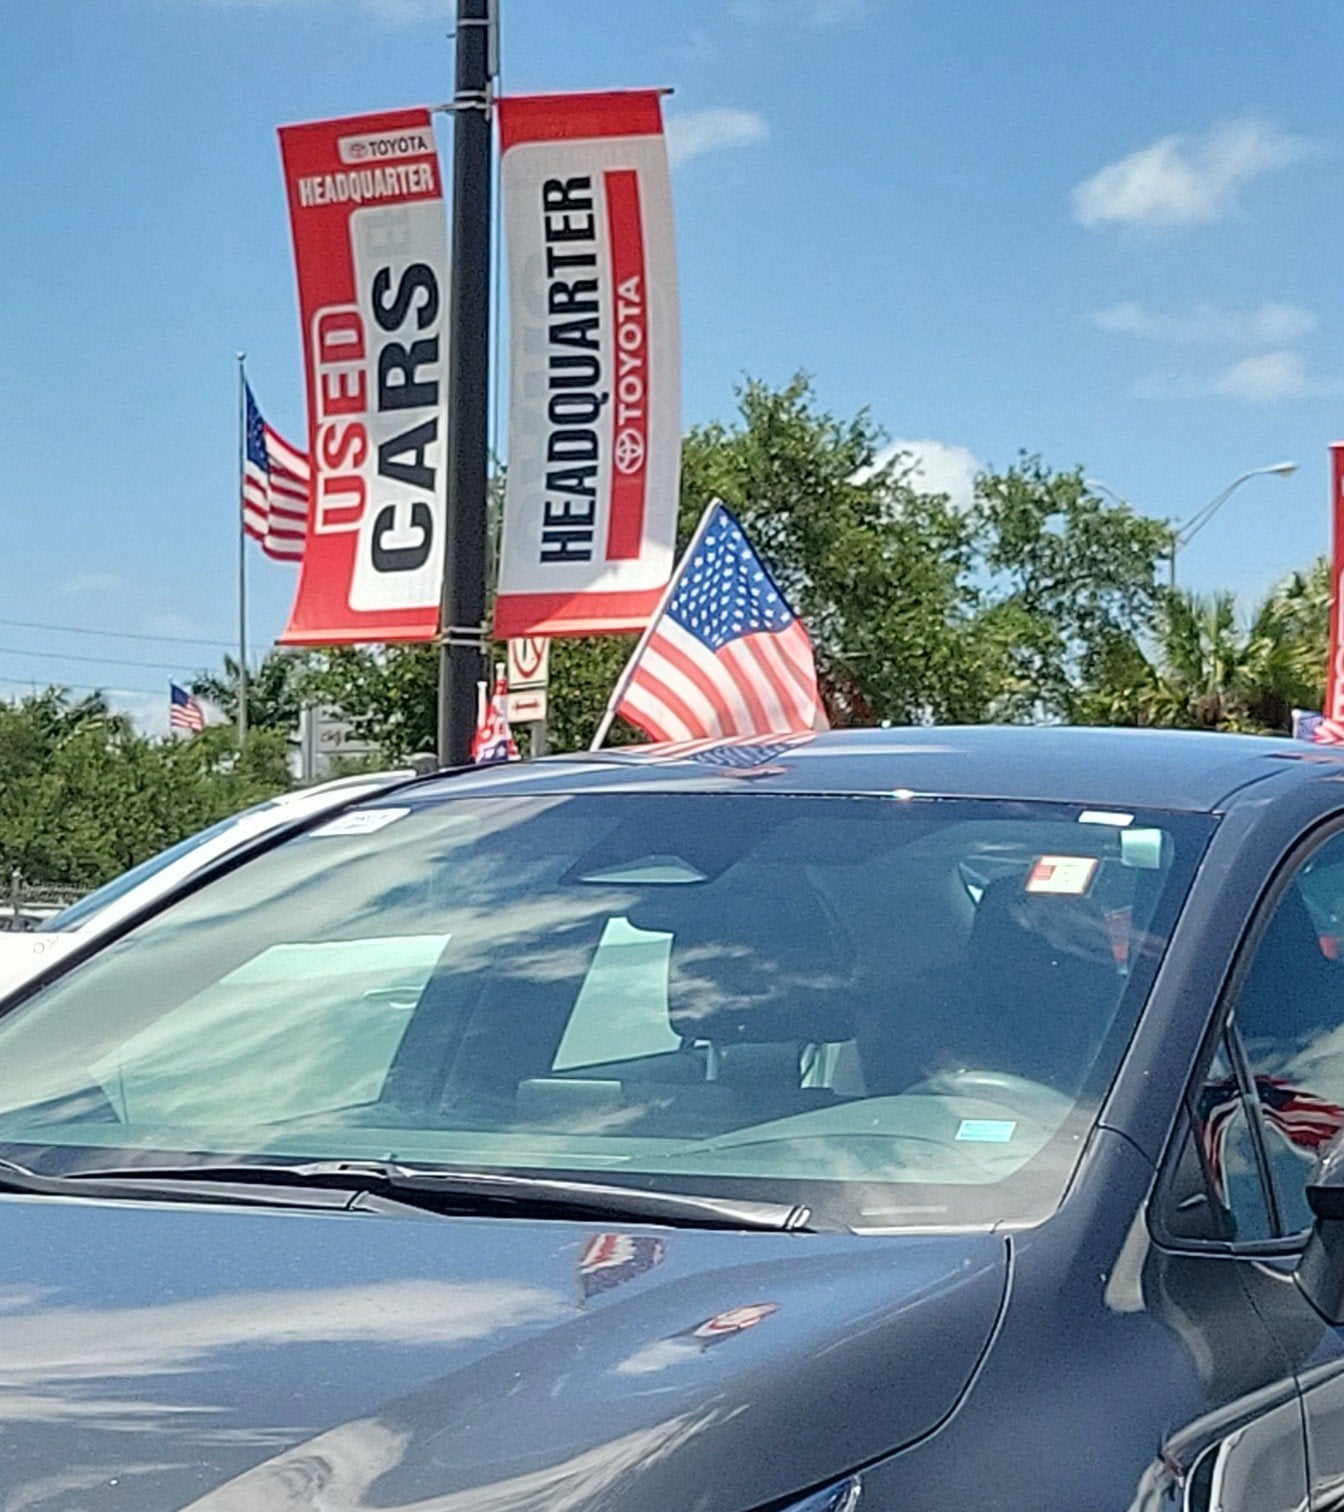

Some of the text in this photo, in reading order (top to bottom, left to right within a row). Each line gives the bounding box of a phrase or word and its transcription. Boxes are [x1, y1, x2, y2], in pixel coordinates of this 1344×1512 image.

[298, 162, 435, 208] HEADQUARTER
[369, 136, 428, 157] TOYOTA
[316, 306, 368, 532] USED
[371, 262, 440, 574] CARS
[540, 174, 610, 563] HEADQUARTER
[617, 274, 644, 426] TOYOTA
